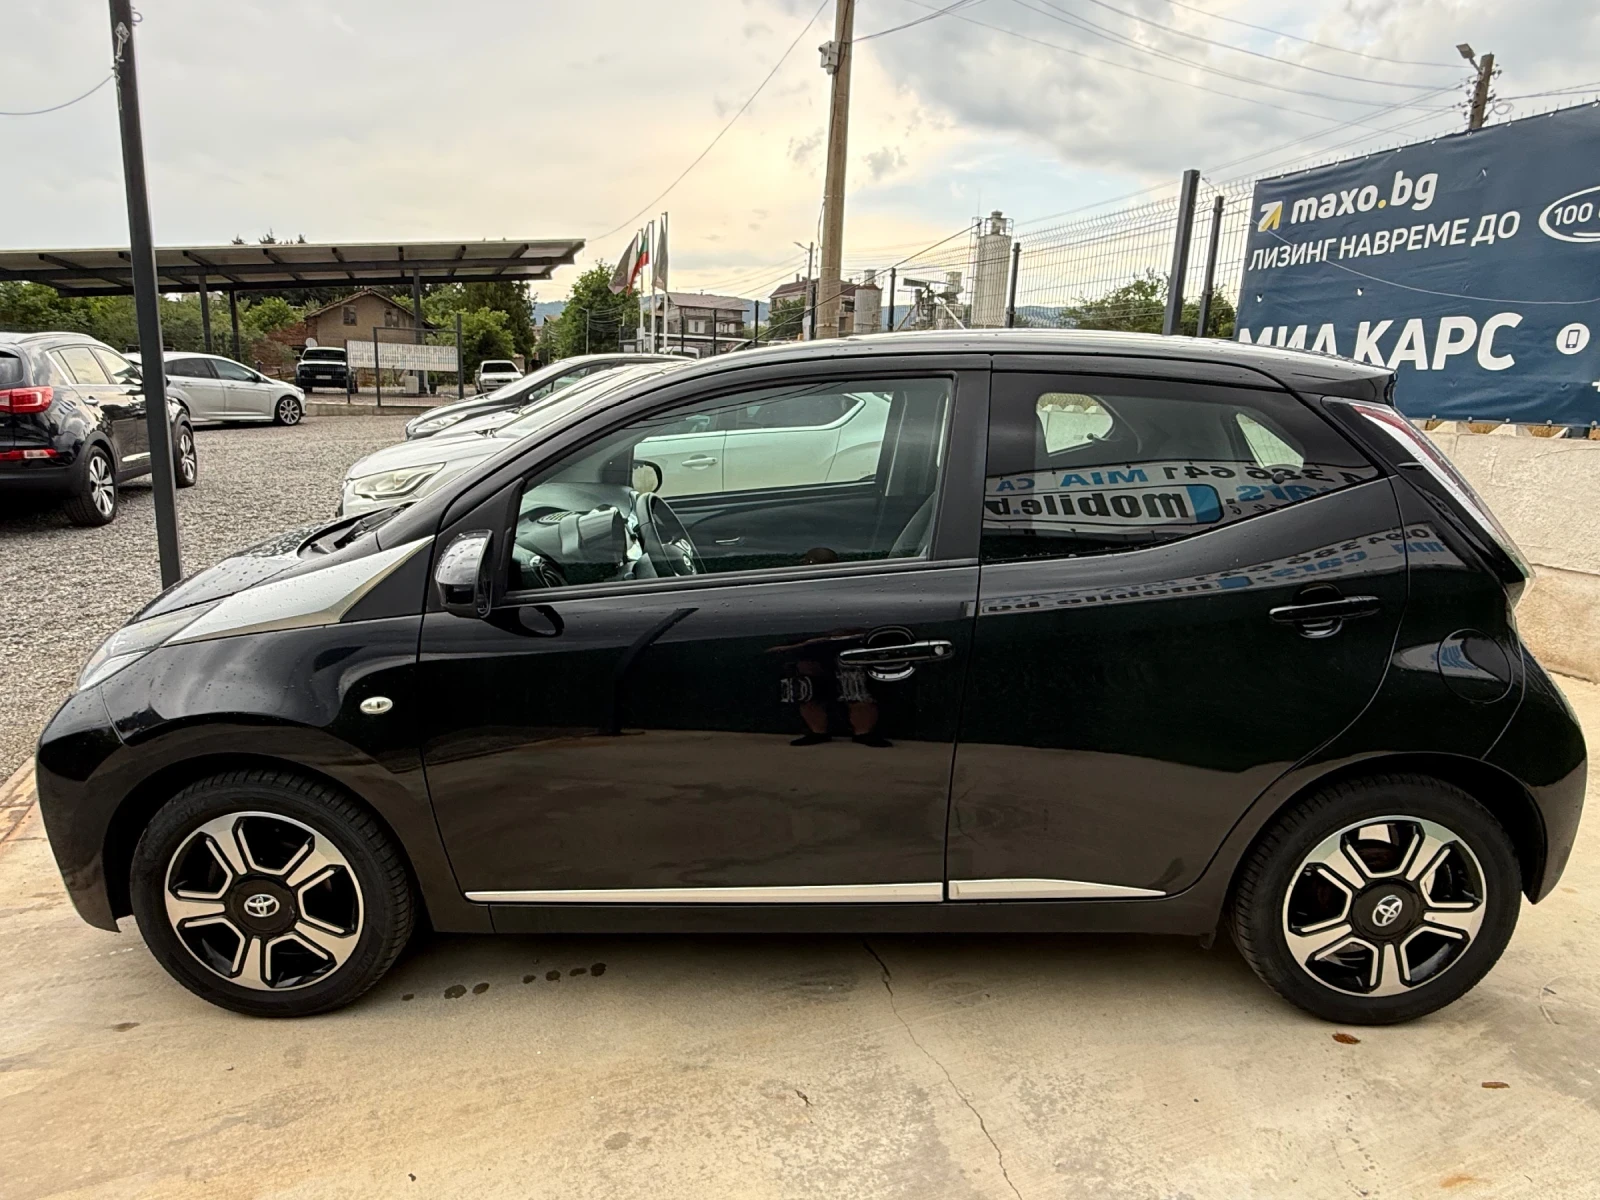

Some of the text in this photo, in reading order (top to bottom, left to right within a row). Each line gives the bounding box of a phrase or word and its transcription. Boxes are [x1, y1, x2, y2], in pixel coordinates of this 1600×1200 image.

[1291, 171, 1438, 224] maxo.bg
[1554, 202, 1594, 226] 100
[1248, 211, 1521, 271] ЛИЗИНГ НАВРЕМЕ ДО
[1353, 312, 1524, 371] КАРС
